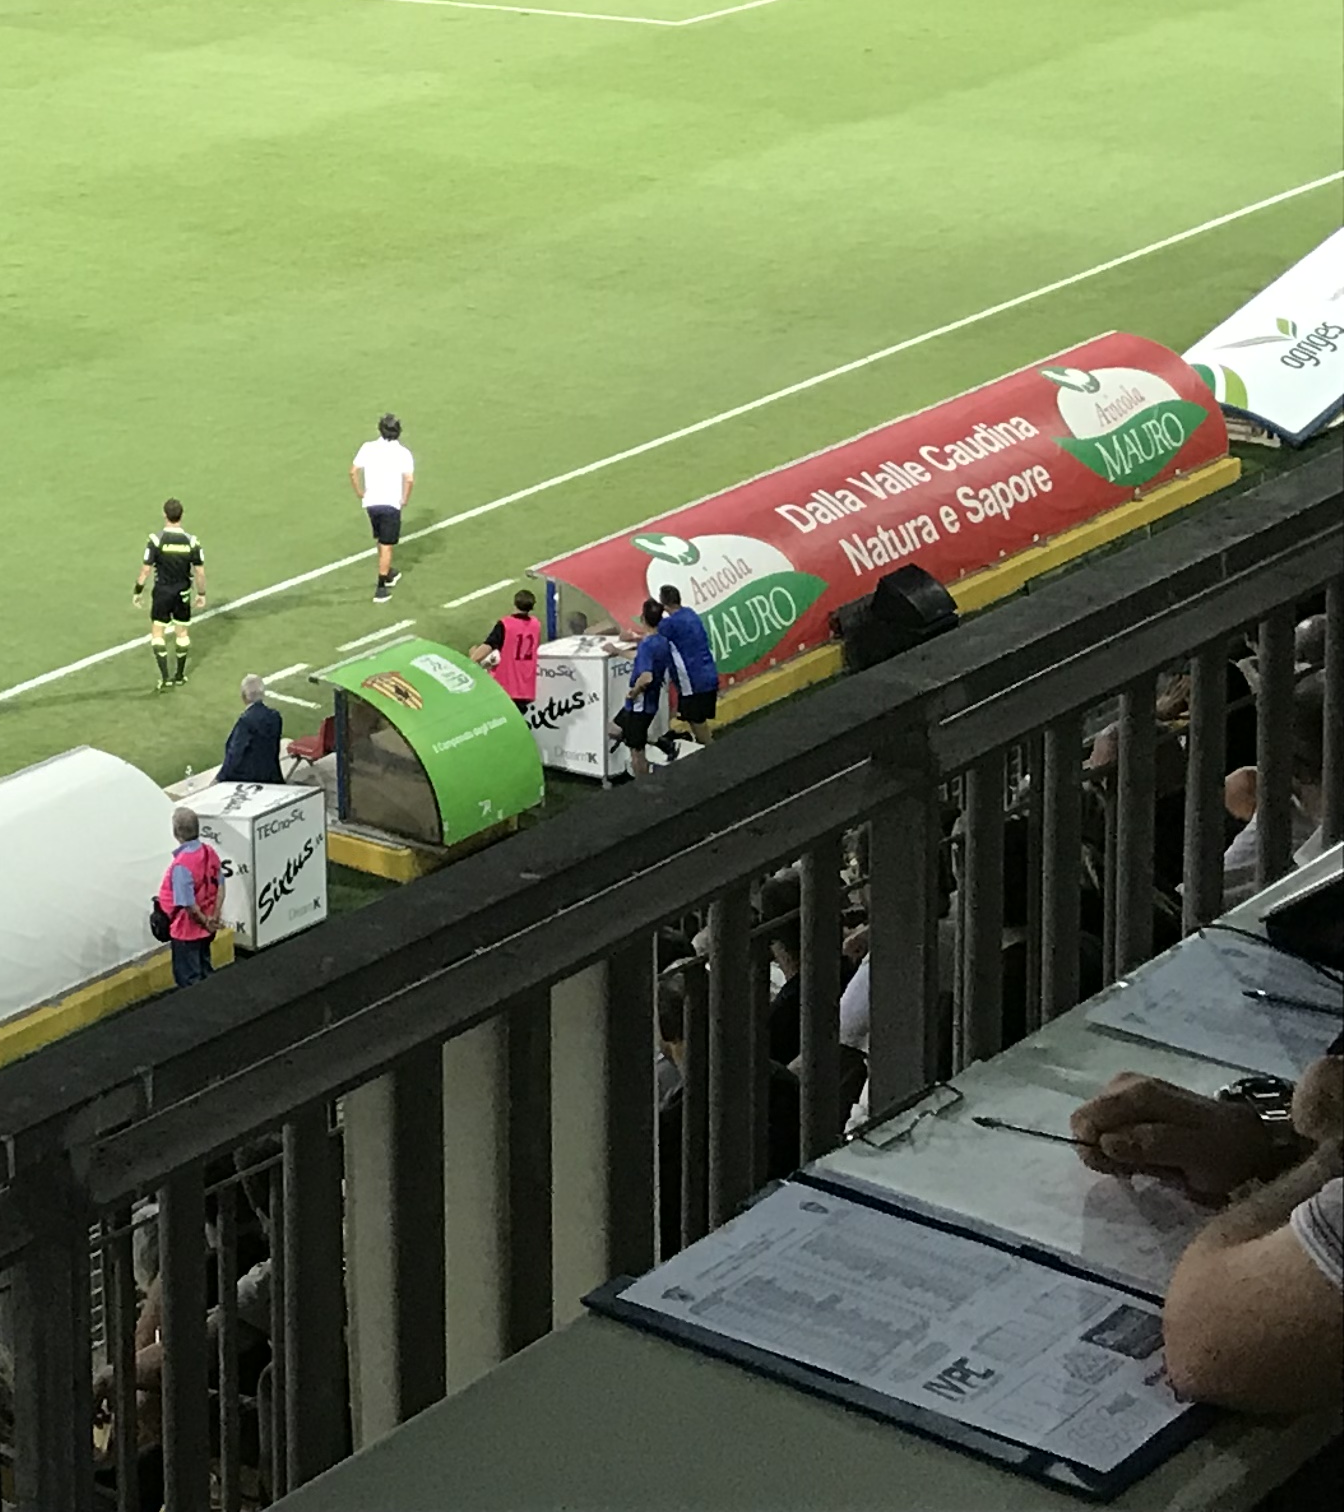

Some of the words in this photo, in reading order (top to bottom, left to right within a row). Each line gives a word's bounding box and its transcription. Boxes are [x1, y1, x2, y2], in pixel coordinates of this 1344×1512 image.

[1095, 382, 1146, 428] Avicola
[1095, 410, 1185, 484] MAURO
[774, 487, 867, 534] Dalla
[847, 460, 933, 502] Valle
[918, 415, 1040, 473] Caudina
[838, 513, 940, 577] Natura
[940, 505, 961, 534] e
[957, 464, 1054, 525] Sapore
[689, 554, 753, 606] Avicola
[515, 633, 534, 661] 12
[922, 1355, 996, 1403] IVPC
